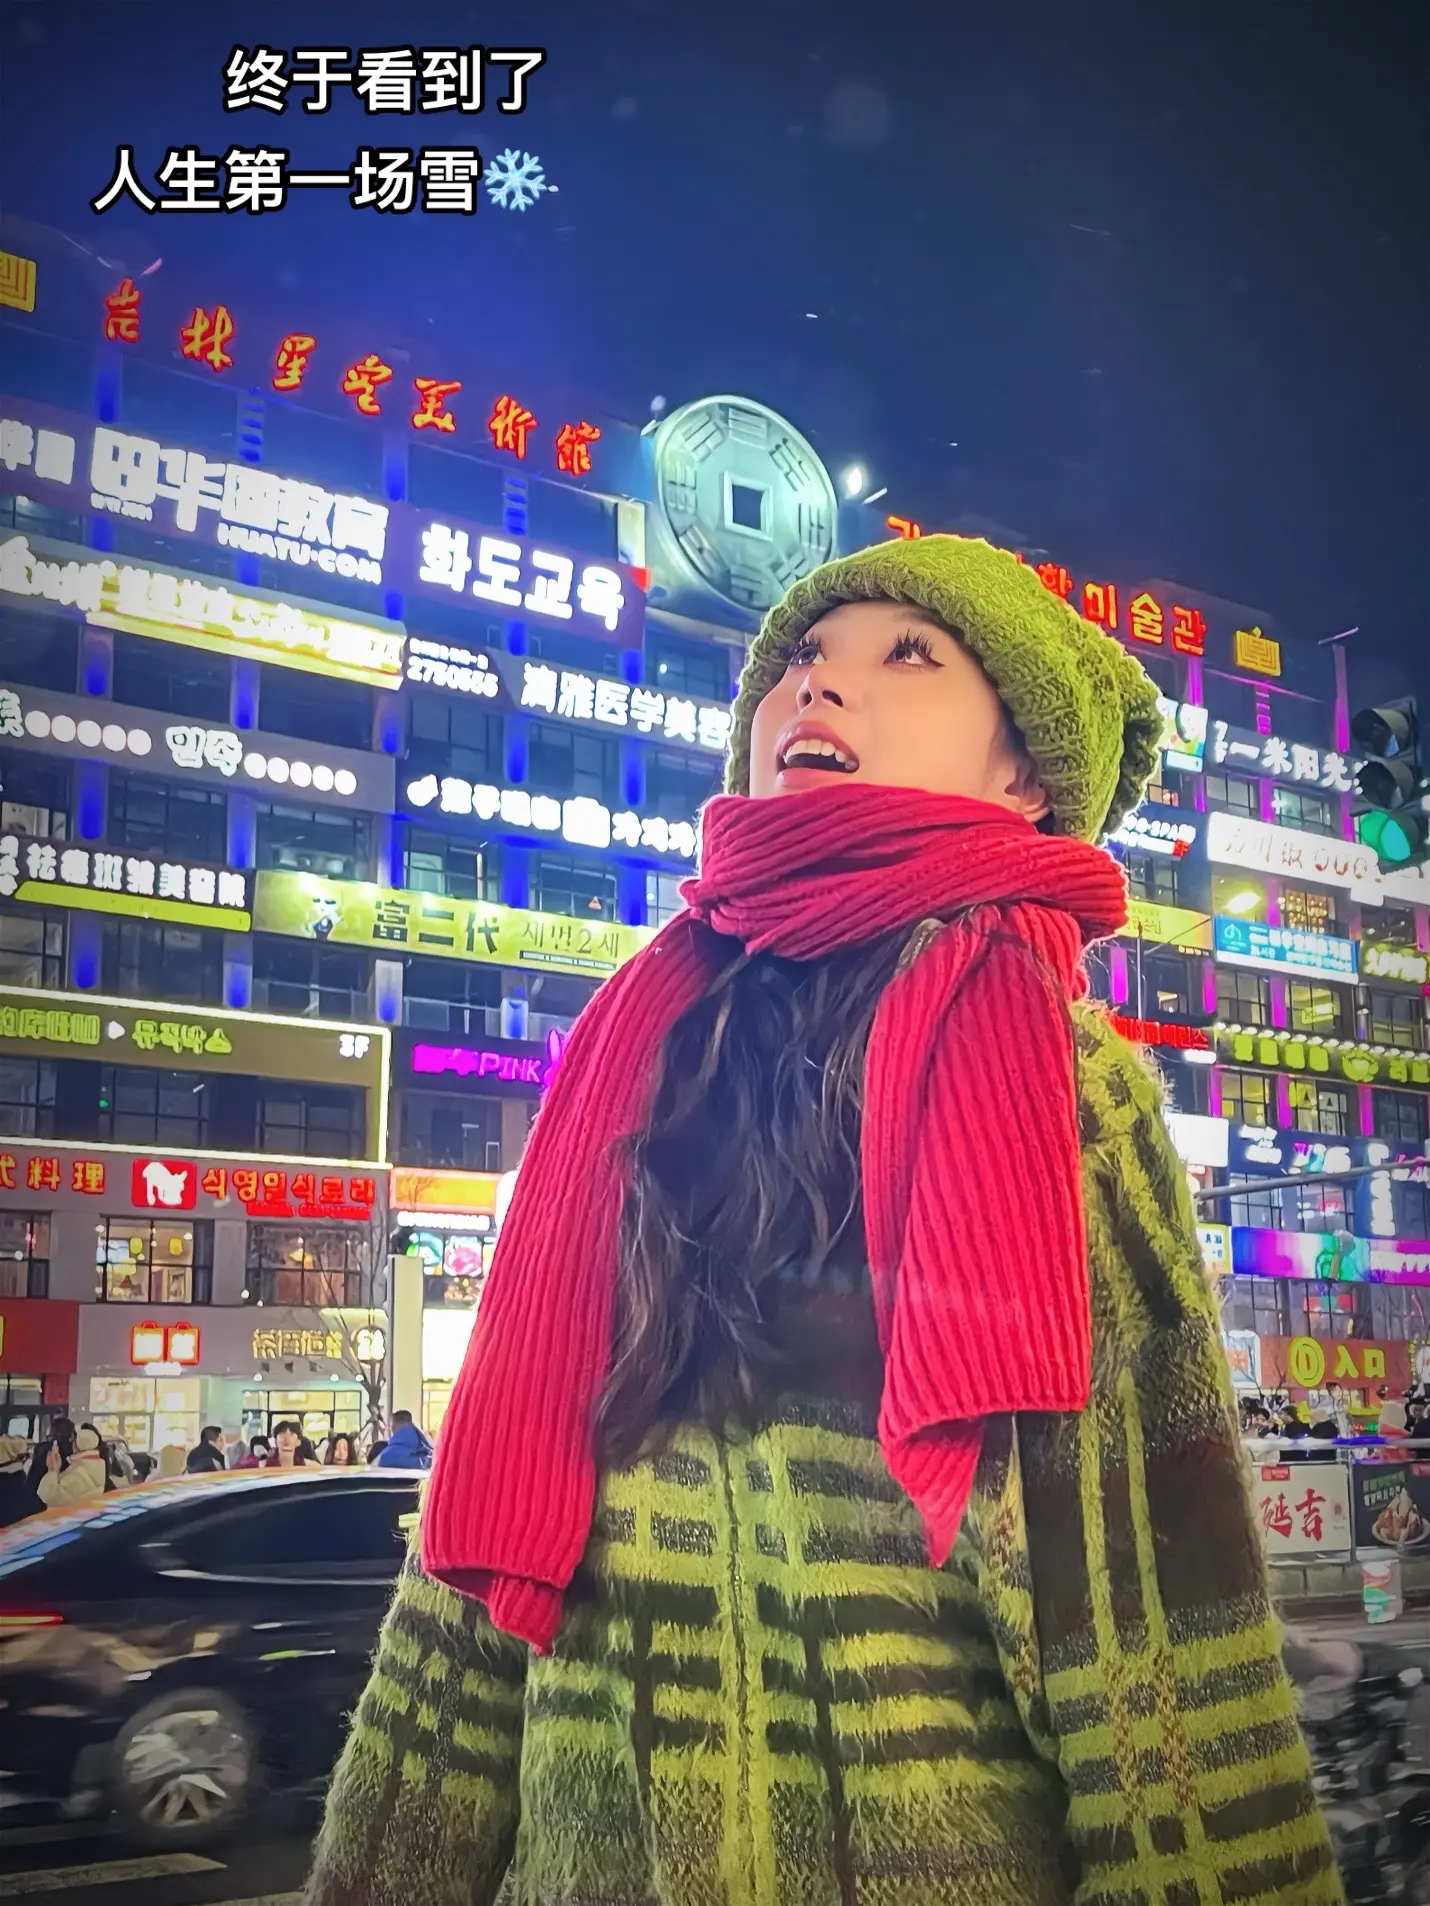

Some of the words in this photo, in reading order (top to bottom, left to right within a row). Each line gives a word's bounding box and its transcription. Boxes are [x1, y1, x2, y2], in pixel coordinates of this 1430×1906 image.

[419, 523, 625, 631] 화도교육
[1229, 736, 1367, 793] 一米阳光
[373, 899, 500, 954] 富二代
[339, 1034, 370, 1059] 3F
[479, 1052, 543, 1083] PINK
[1259, 1488, 1326, 1542] 延吉
